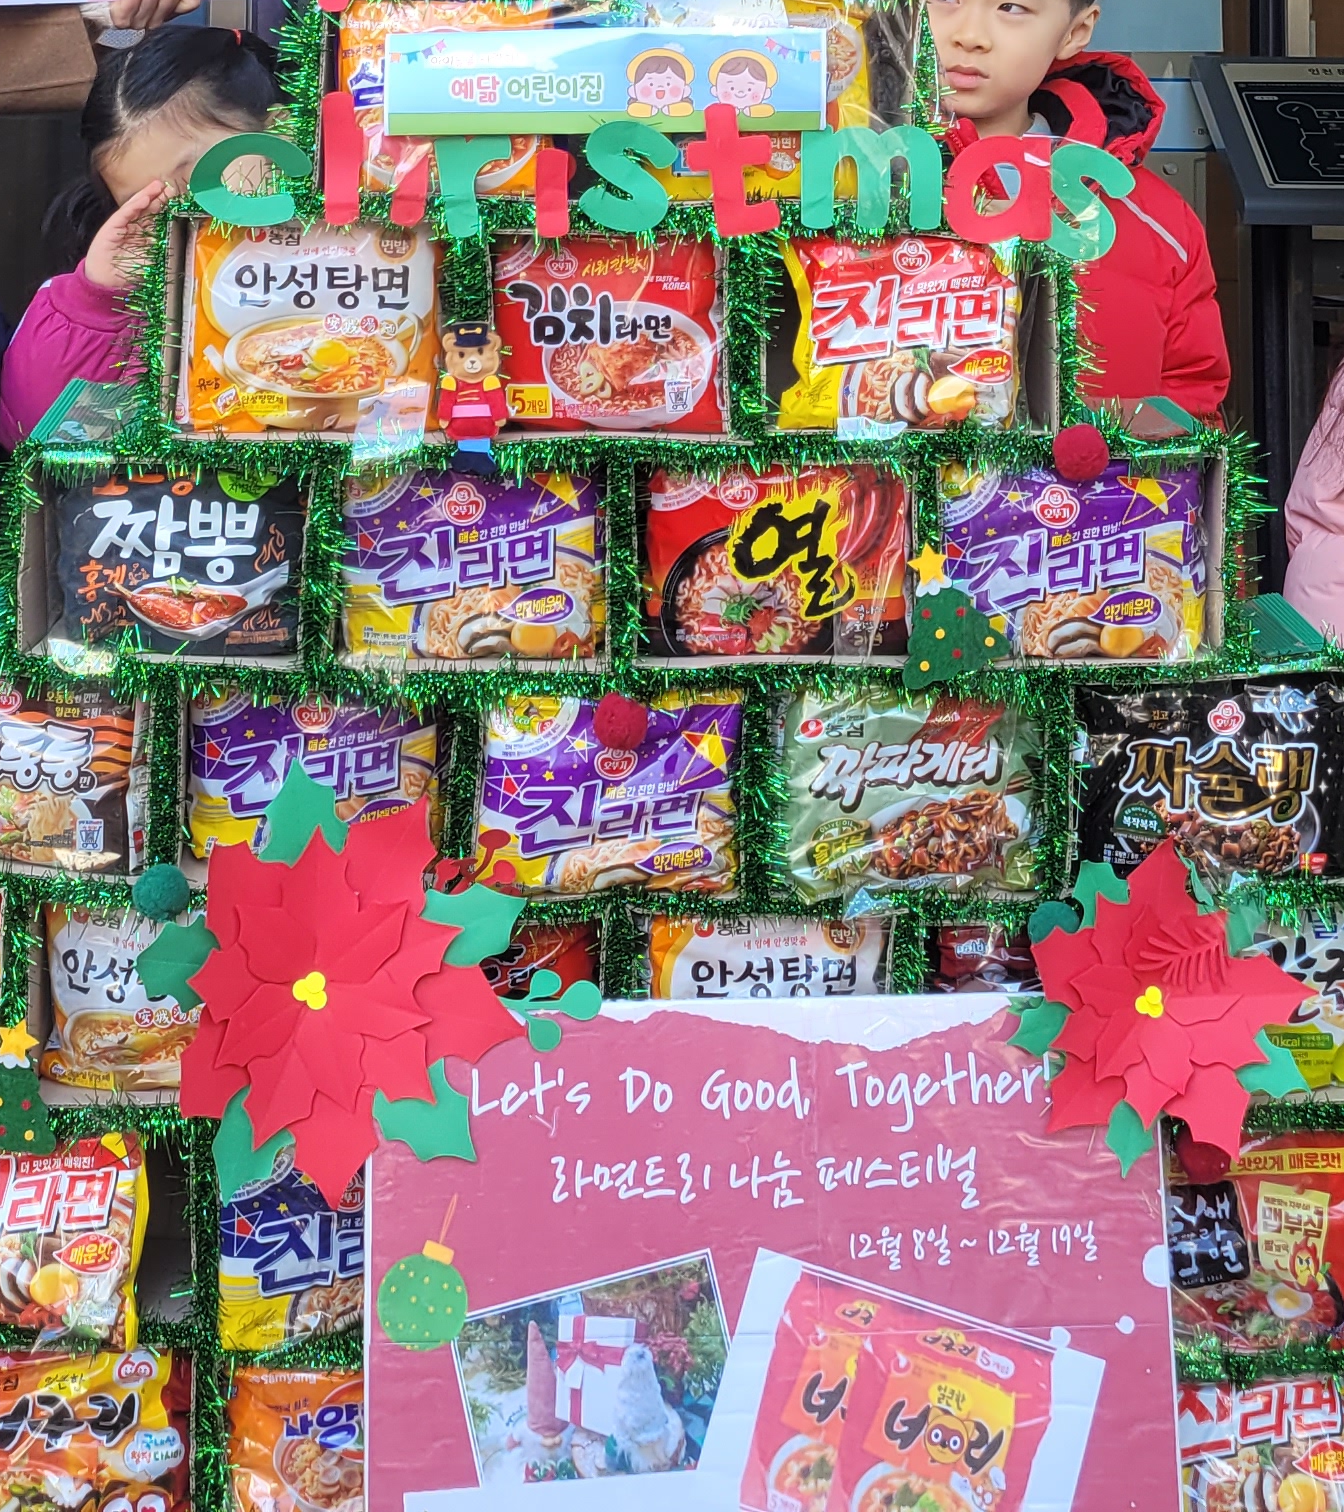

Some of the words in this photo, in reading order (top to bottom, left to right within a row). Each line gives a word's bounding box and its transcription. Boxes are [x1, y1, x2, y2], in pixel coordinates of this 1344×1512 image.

[508, 73, 604, 105] 어린이집
[268, 229, 301, 246] 농심
[380, 239, 409, 255] 면발
[235, 262, 411, 310] 안성탕면
[662, 282, 691, 290] KOREA
[811, 275, 1004, 364] 진라면
[965, 356, 1008, 376] 매운맛
[511, 387, 548, 414] 5개입
[451, 504, 476, 516] 오뚜기
[1044, 508, 1070, 518] 오뚜기
[89, 495, 260, 582] 짬뽕
[378, 527, 557, 607] 진라면
[732, 499, 857, 617] 열
[968, 529, 1145, 616] 진라면
[78, 560, 126, 601] 홍게
[516, 594, 566, 617] 약간매운맛
[1104, 598, 1154, 621] 약간매운맛
[824, 722, 864, 738] 농심
[810, 738, 1003, 813] 짜파게티
[1119, 738, 1317, 824] 짜슐랭
[516, 779, 703, 858] 진라면
[1122, 816, 1158, 831] 복작복작
[653, 850, 705, 871] 약간매운맛
[691, 954, 856, 998] 안성탕면
[470, 1060, 589, 1117] Let's
[619, 1067, 673, 1115] Do
[836, 1052, 1054, 1133] Together!
[32, 1159, 61, 1172] 맛있게
[64, 1157, 95, 1170] 매워진!
[550, 1152, 711, 1204] 라면트리
[729, 1151, 804, 1208] 나눔
[817, 1144, 981, 1209] 페스티벌
[1237, 1154, 1284, 1171] 맛있게
[1289, 1153, 1341, 1170] 매운맛!
[1262, 1205, 1324, 1238] 맵부심
[70, 1243, 112, 1265] 매운맛
[850, 1229, 902, 1270] 12월
[913, 1223, 951, 1265] 8일
[988, 1226, 1042, 1268] 12월
[1052, 1222, 1099, 1262] 19일
[261, 1373, 317, 1385] Samyang
[936, 1382, 967, 1414] 얼큰한
[884, 1399, 1006, 1477] 너리
